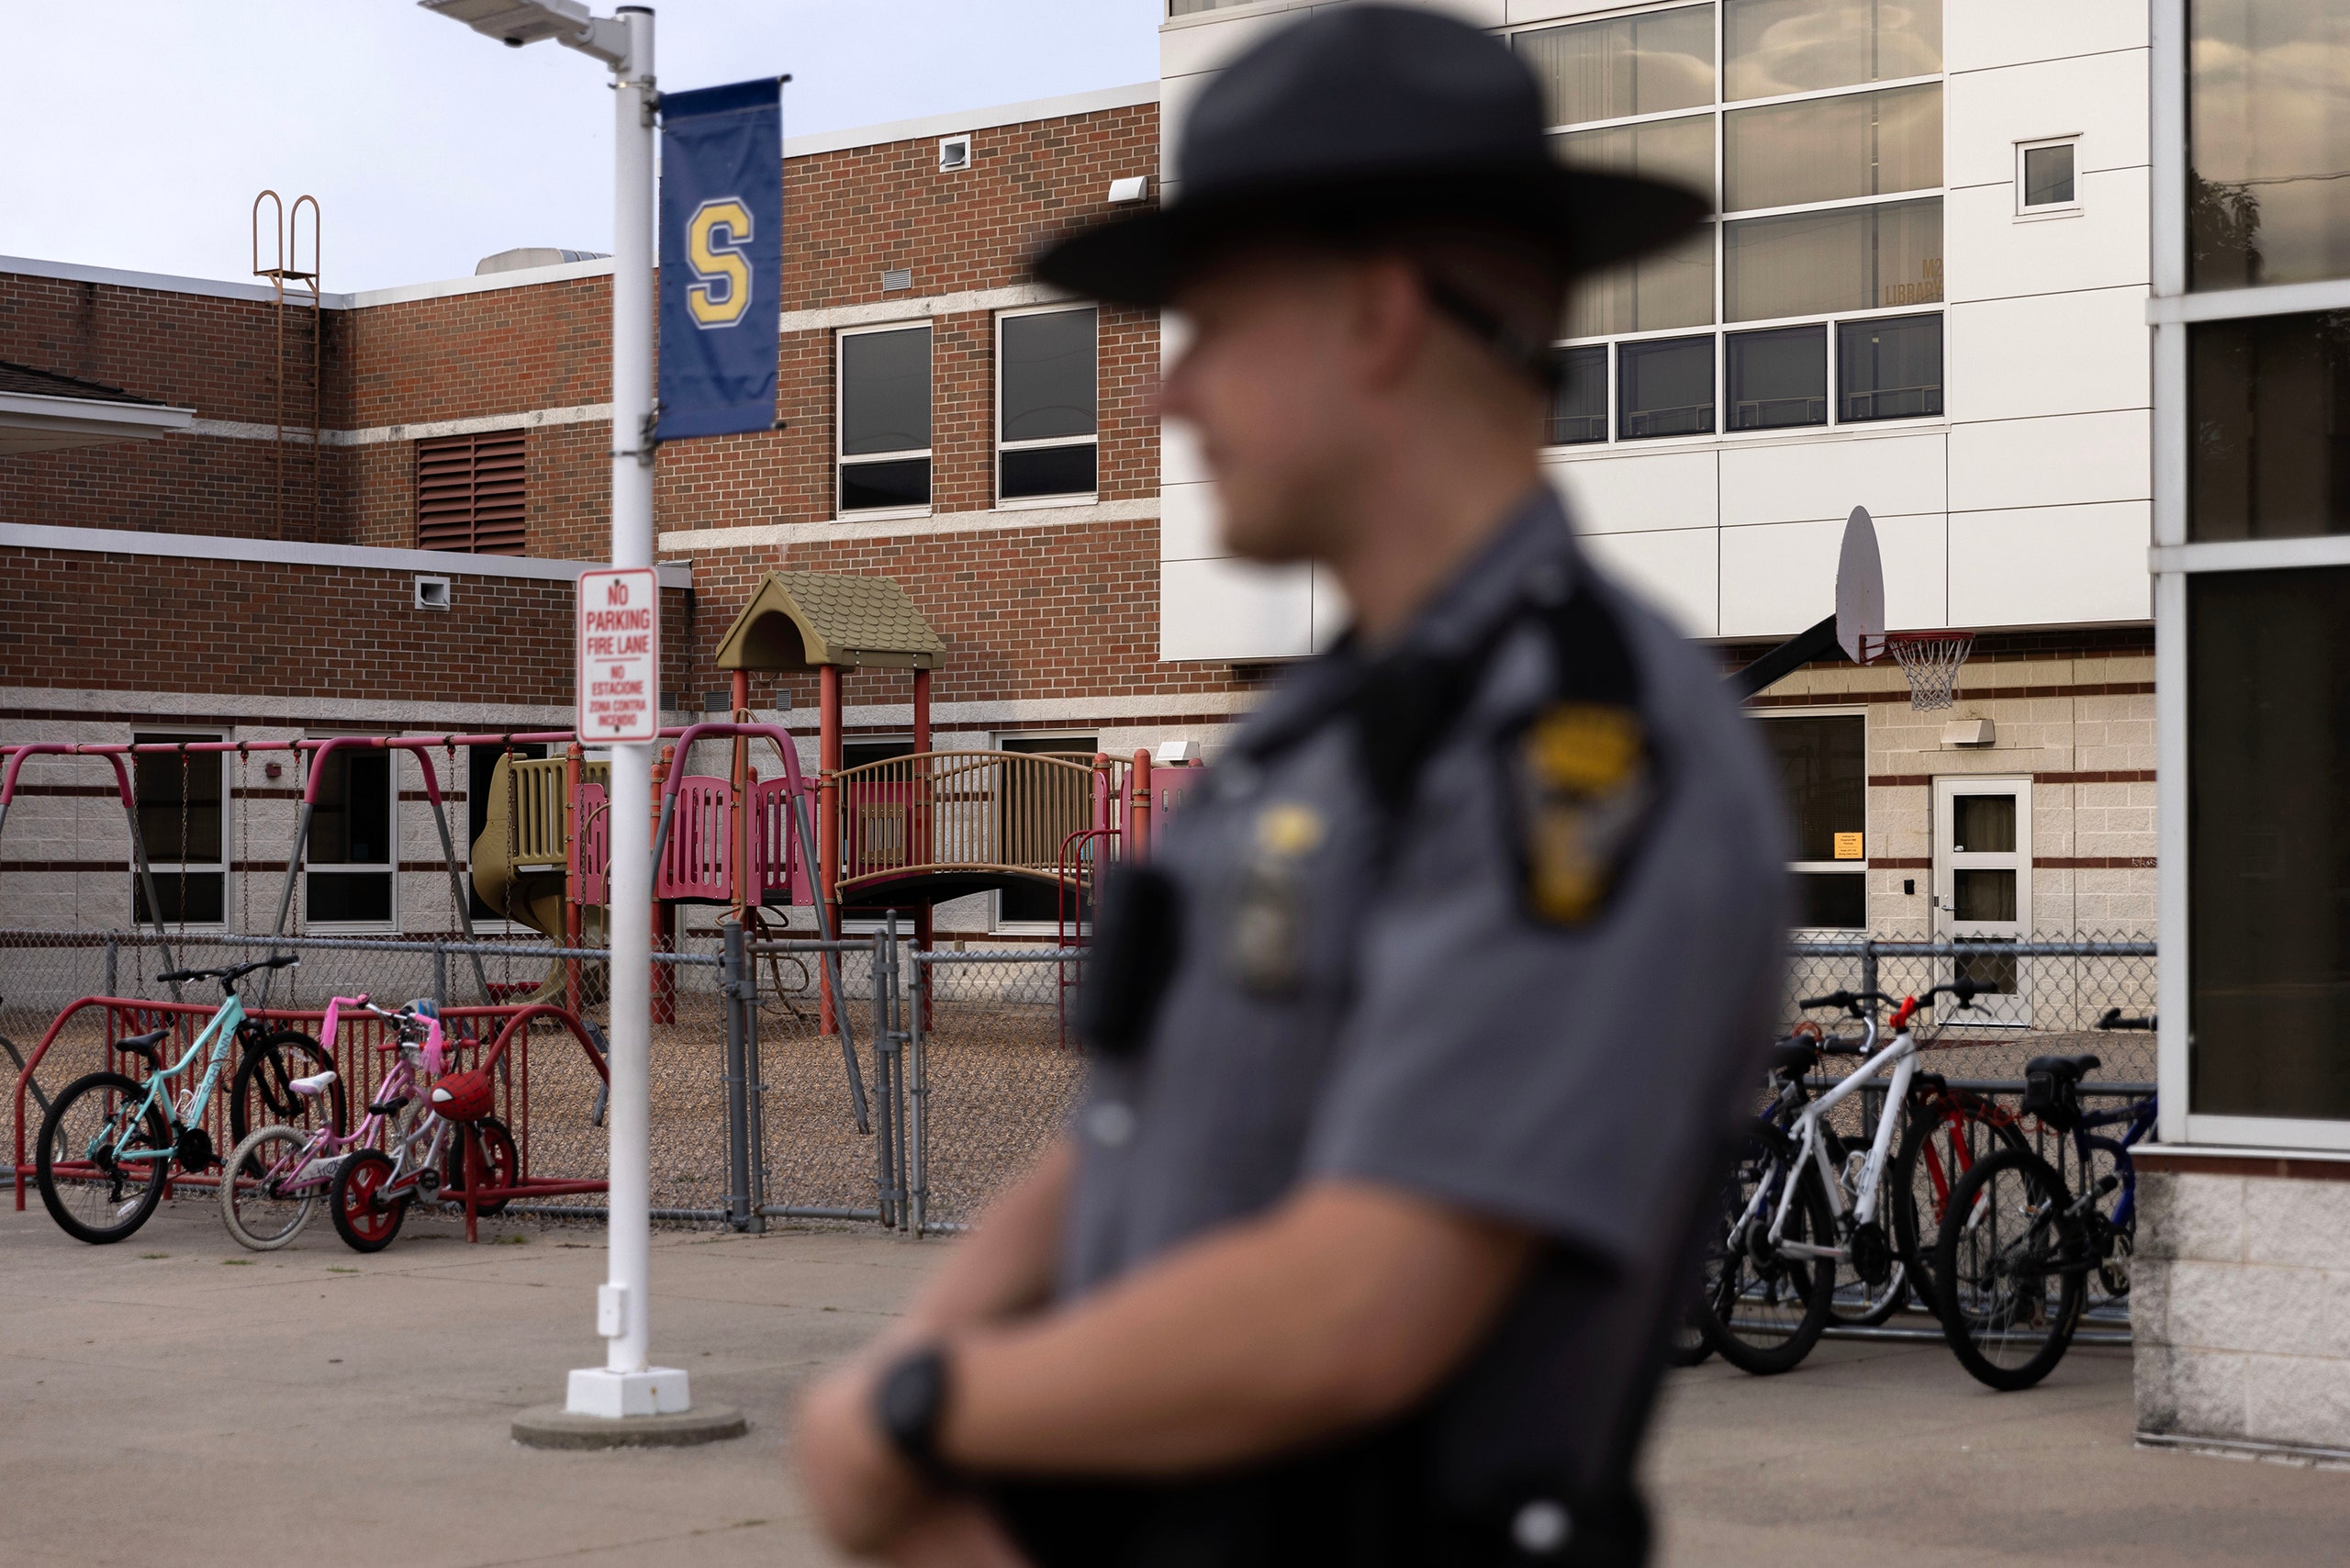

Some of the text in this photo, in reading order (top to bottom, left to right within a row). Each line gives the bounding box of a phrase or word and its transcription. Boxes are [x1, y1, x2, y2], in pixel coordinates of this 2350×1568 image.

[687, 196, 754, 330] S
[1885, 280, 1942, 305] LIBRARY
[608, 585, 629, 606] NO
[586, 609, 650, 632] PARKING
[587, 634, 650, 655] FIRE LANE
[610, 665, 625, 679] NO
[591, 680, 644, 697] ESTACIONE
[589, 700, 646, 713] ZONA CONTRA
[202, 1032, 232, 1094] SCHWINN
